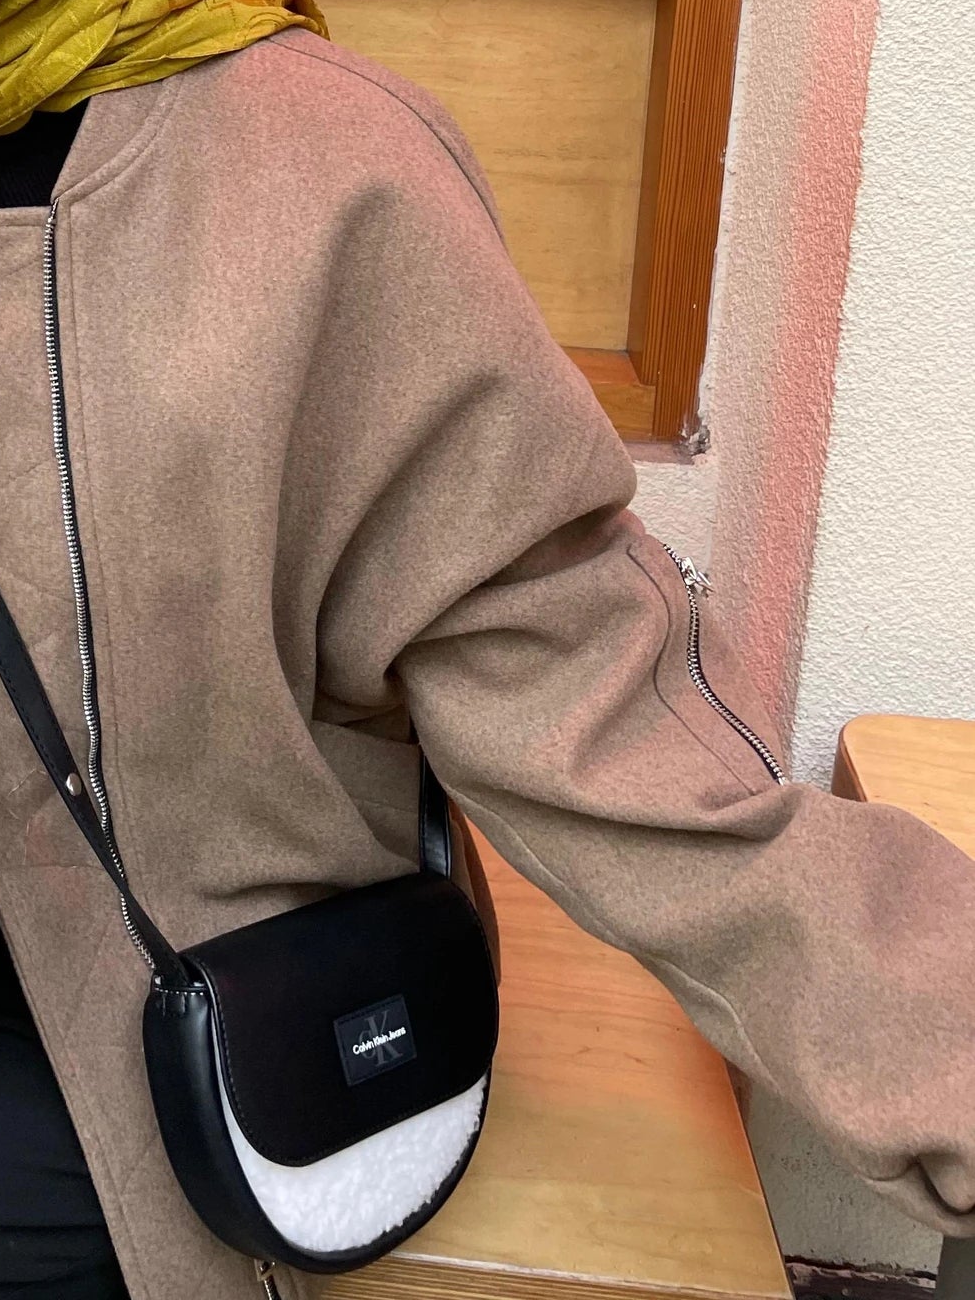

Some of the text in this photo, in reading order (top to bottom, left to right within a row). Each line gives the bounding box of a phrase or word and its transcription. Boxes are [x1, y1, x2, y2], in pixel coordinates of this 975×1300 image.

[352, 1026, 406, 1055] Calvin Klein Jeans
